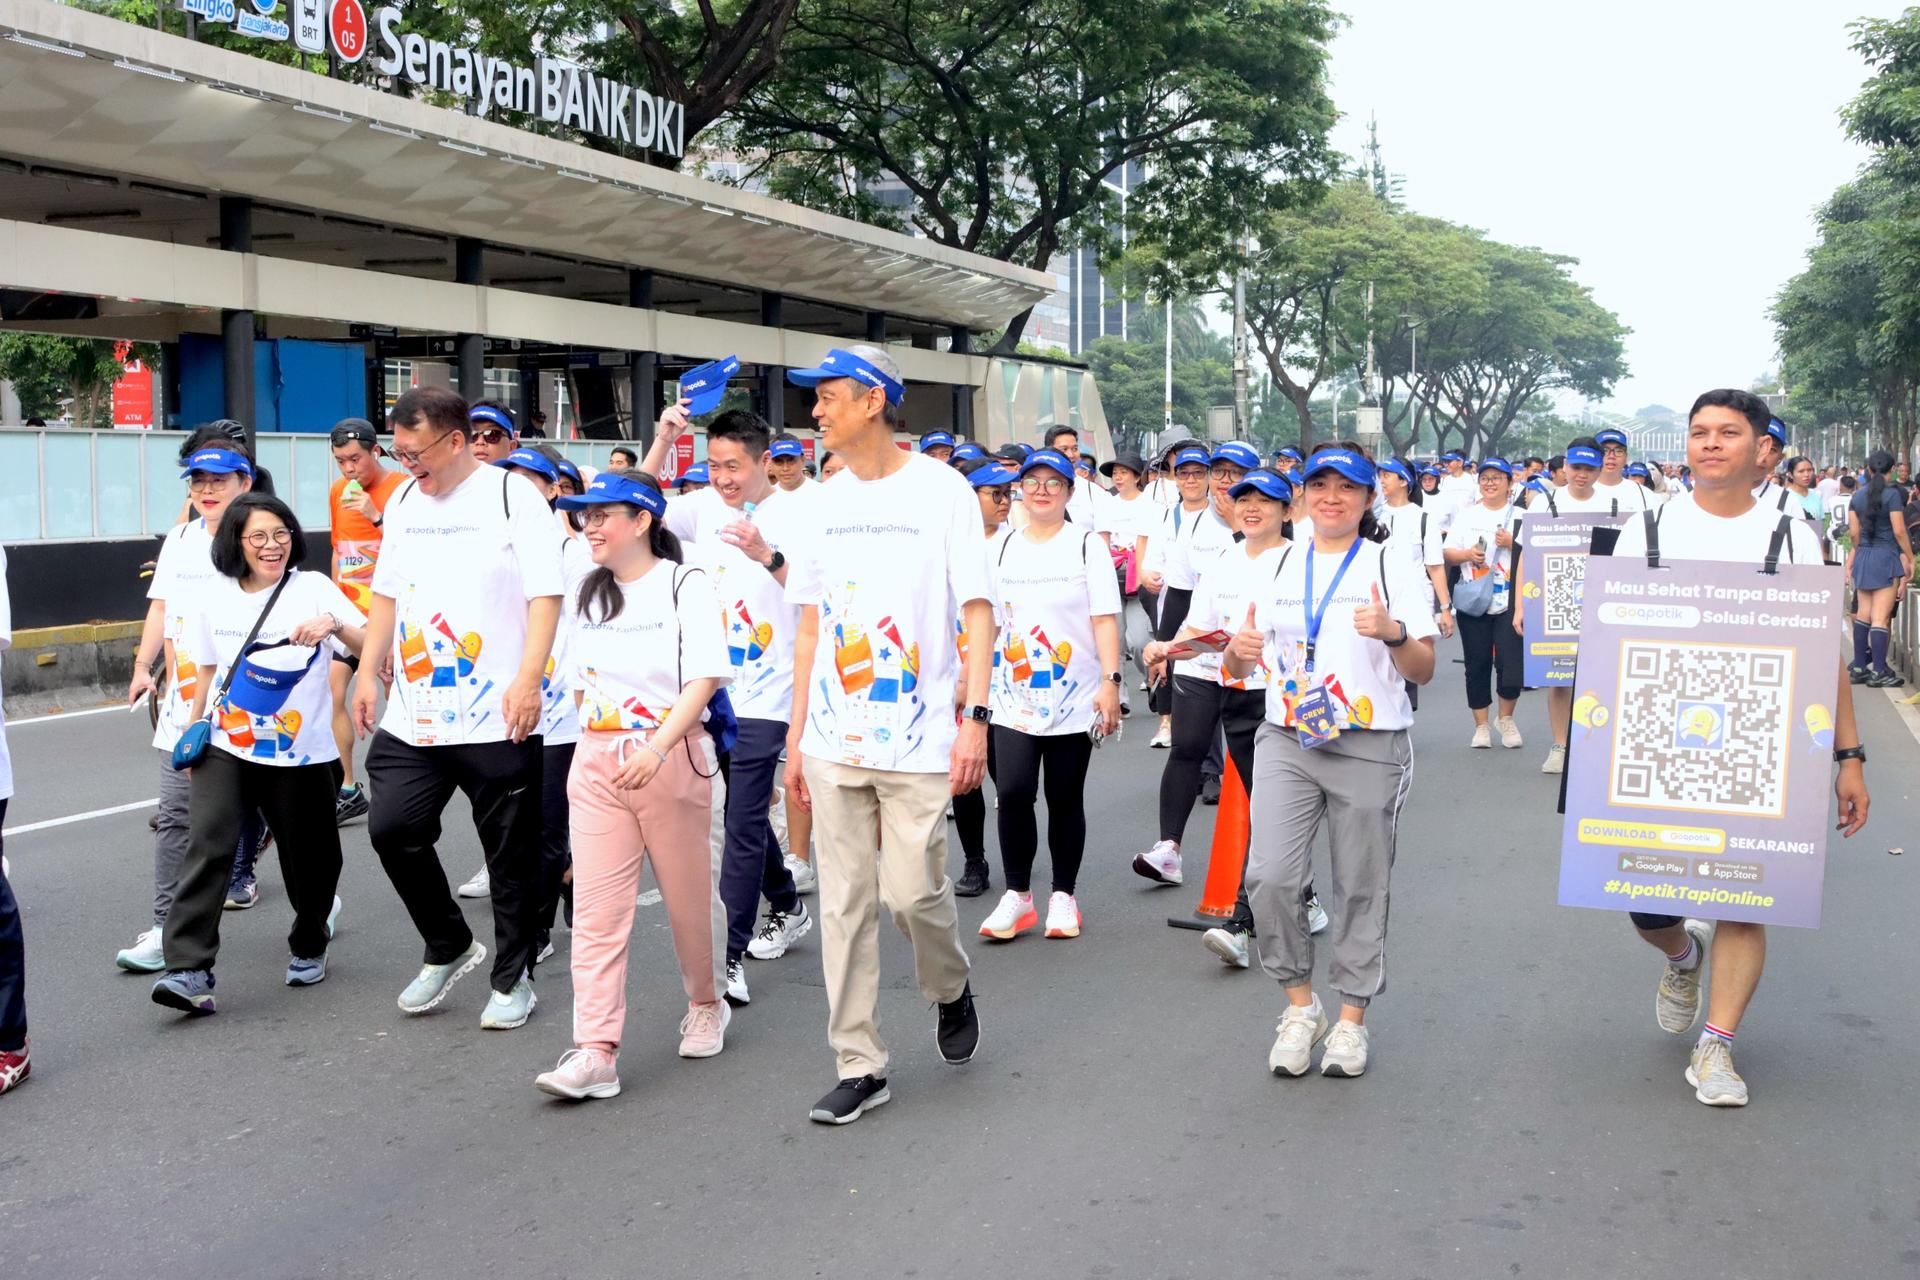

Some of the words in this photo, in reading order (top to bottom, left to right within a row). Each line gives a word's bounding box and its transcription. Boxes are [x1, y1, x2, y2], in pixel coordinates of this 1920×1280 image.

[345, 6, 352, 23] 1
[241, 14, 288, 37] transjakarta
[302, 26, 318, 40] BRT
[341, 30, 356, 49] 05
[379, 6, 535, 117] Senayan
[542, 58, 631, 143] BANK
[635, 89, 684, 158] DKI
[1316, 456, 1353, 465] Goapotik
[826, 524, 920, 536] #ApotikTapiOnline
[1532, 524, 1552, 532] Mau
[1554, 524, 1580, 532] Sehat
[345, 556, 363, 566] 1129
[1604, 581, 1644, 595] Mau
[1647, 583, 1701, 598] Sehat
[1703, 585, 1762, 604] Tanpa
[1766, 588, 1832, 604] Batas?
[1615, 606, 1683, 621] Goapotik
[1702, 611, 1754, 625] Solusi
[1757, 614, 1828, 629] Cerdas!
[245, 669, 277, 685] Goapotik
[1302, 706, 1325, 720] CREW
[1583, 826, 1657, 840] DOWNLOAD
[1670, 832, 1711, 843] Goapotik
[1729, 837, 1815, 855] SEKARANG!
[1635, 861, 1665, 872] Google
[1666, 863, 1685, 874] Play
[1714, 869, 1732, 879] App
[1733, 870, 1758, 880] Store
[1603, 879, 1775, 907] #ApotikTapiOnline
